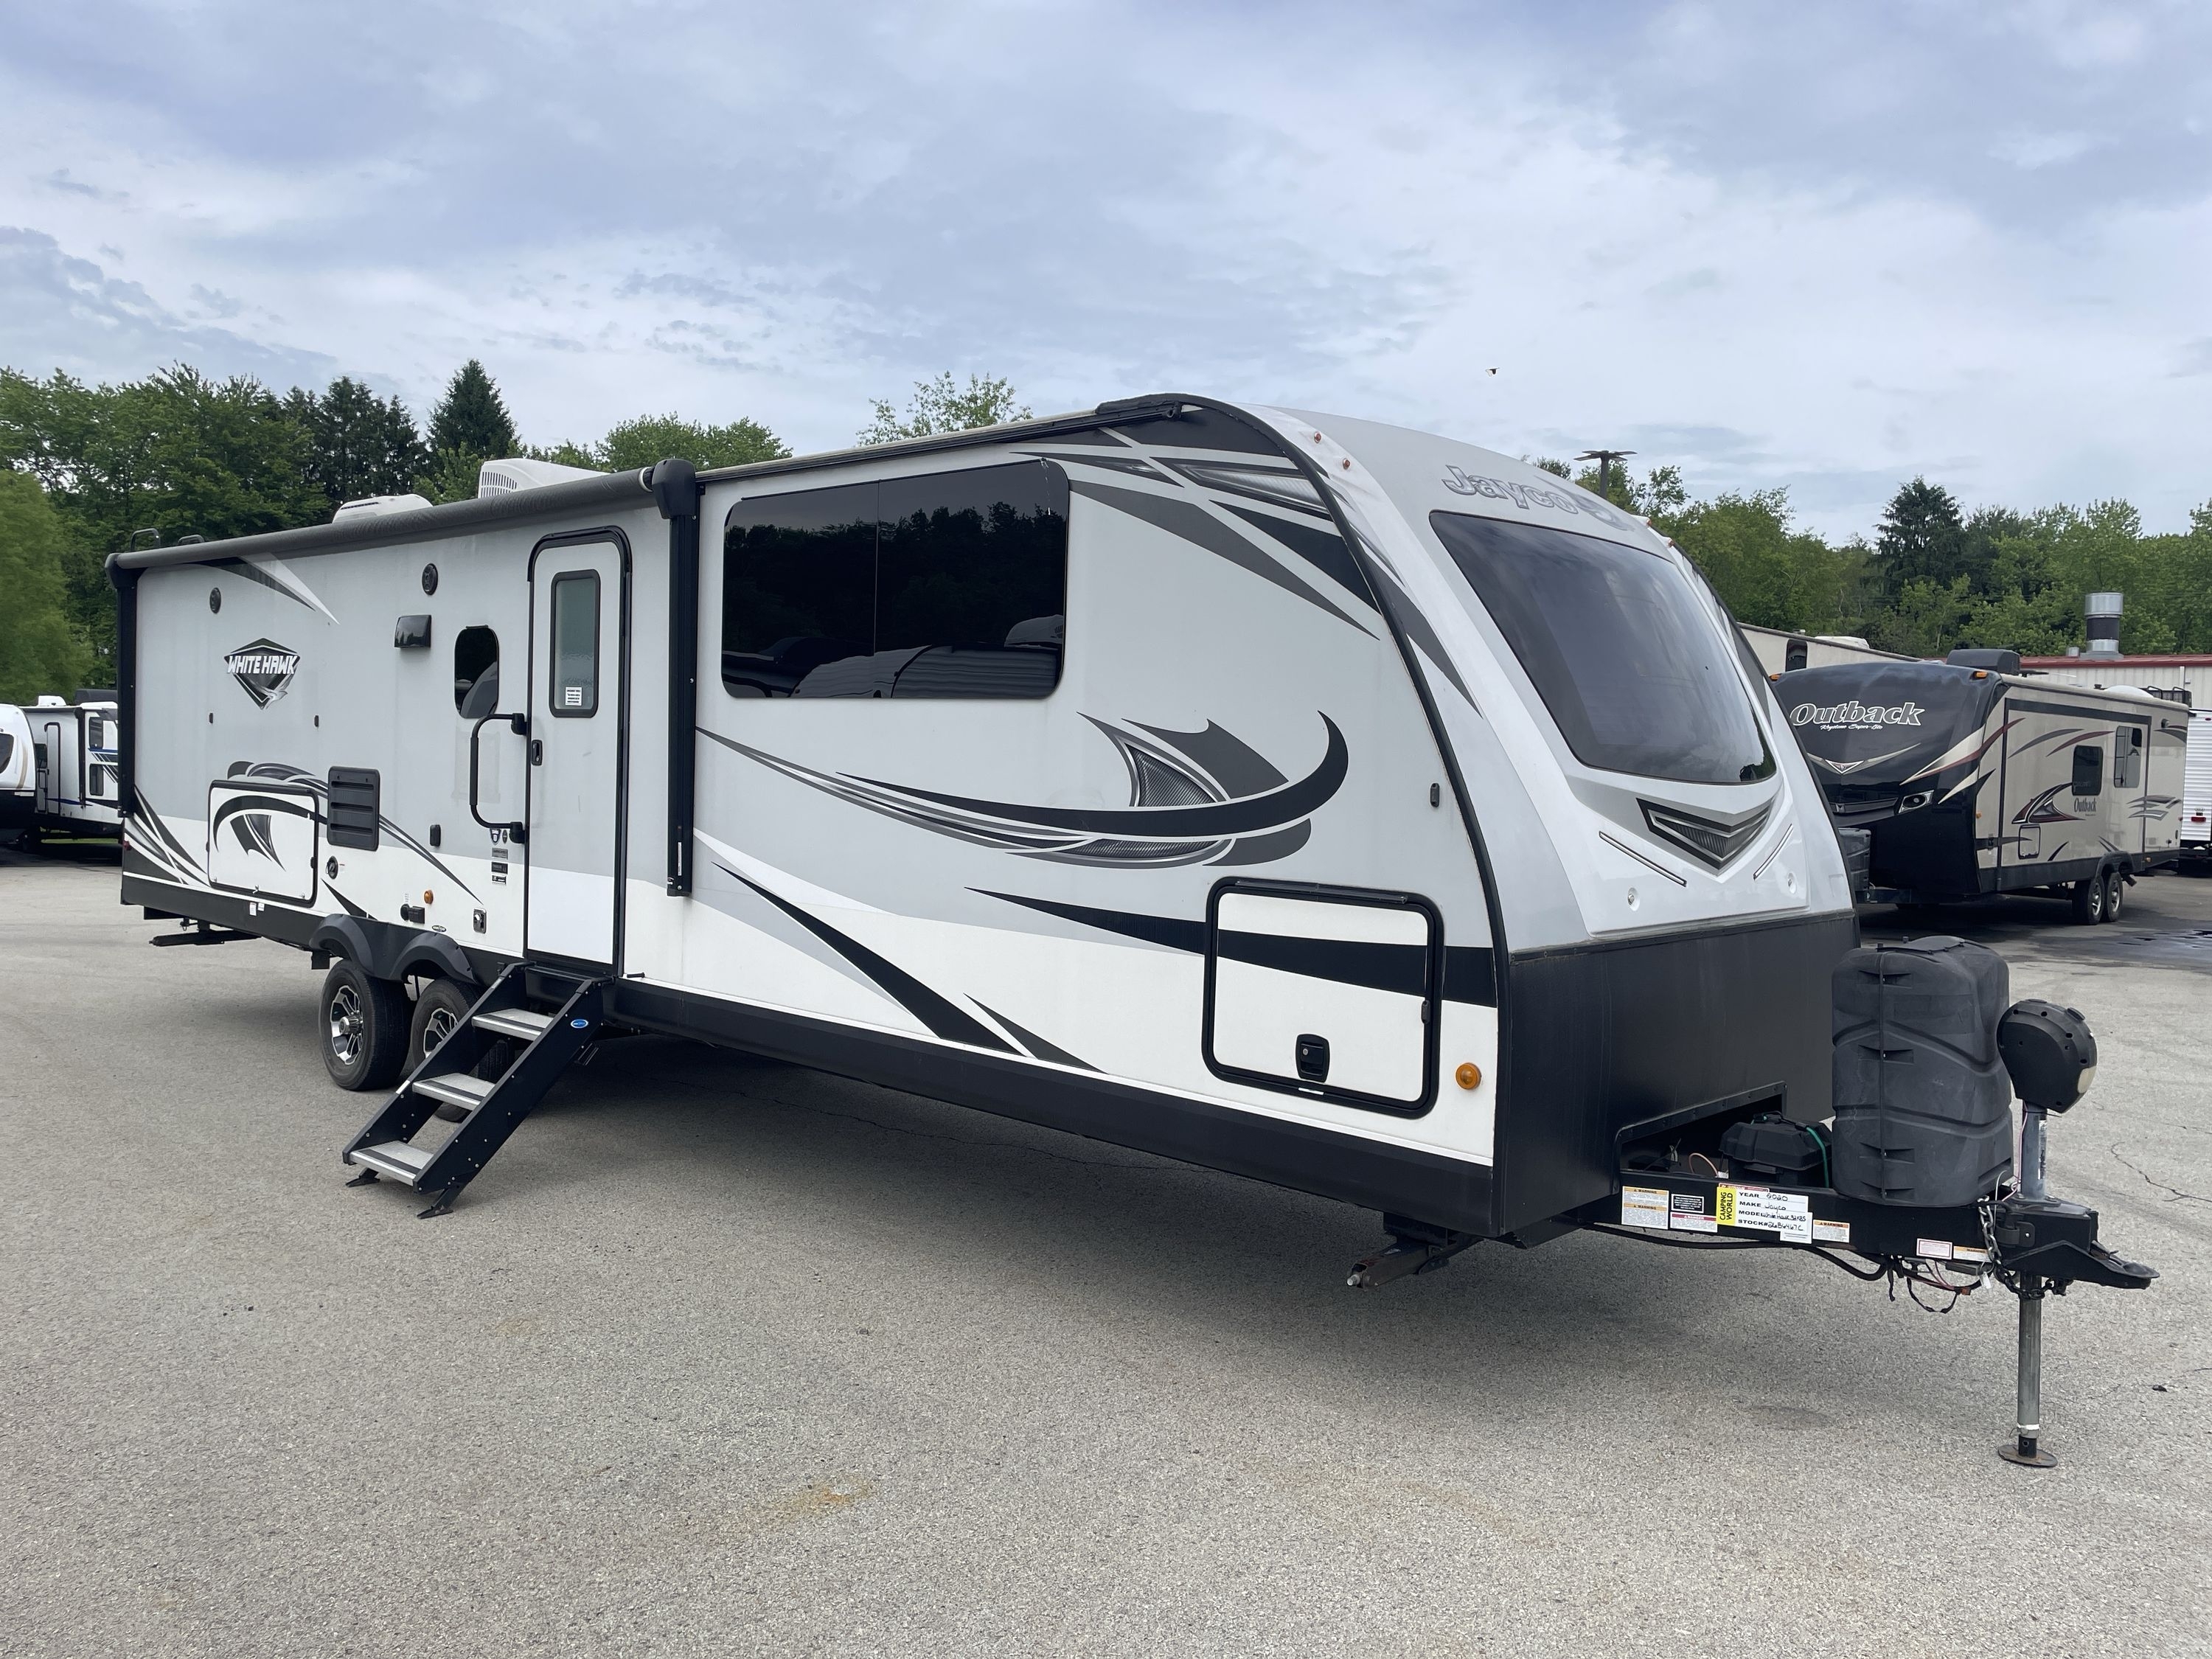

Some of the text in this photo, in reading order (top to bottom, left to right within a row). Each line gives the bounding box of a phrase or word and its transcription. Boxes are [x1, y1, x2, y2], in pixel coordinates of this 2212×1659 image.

[1441, 465, 1579, 515] Jayco
[227, 655, 298, 674] WHITE HAWK
[1790, 700, 1925, 726] Outback
[2073, 797, 2097, 813] Outback
[1719, 1192, 1728, 1220] CAMPING
